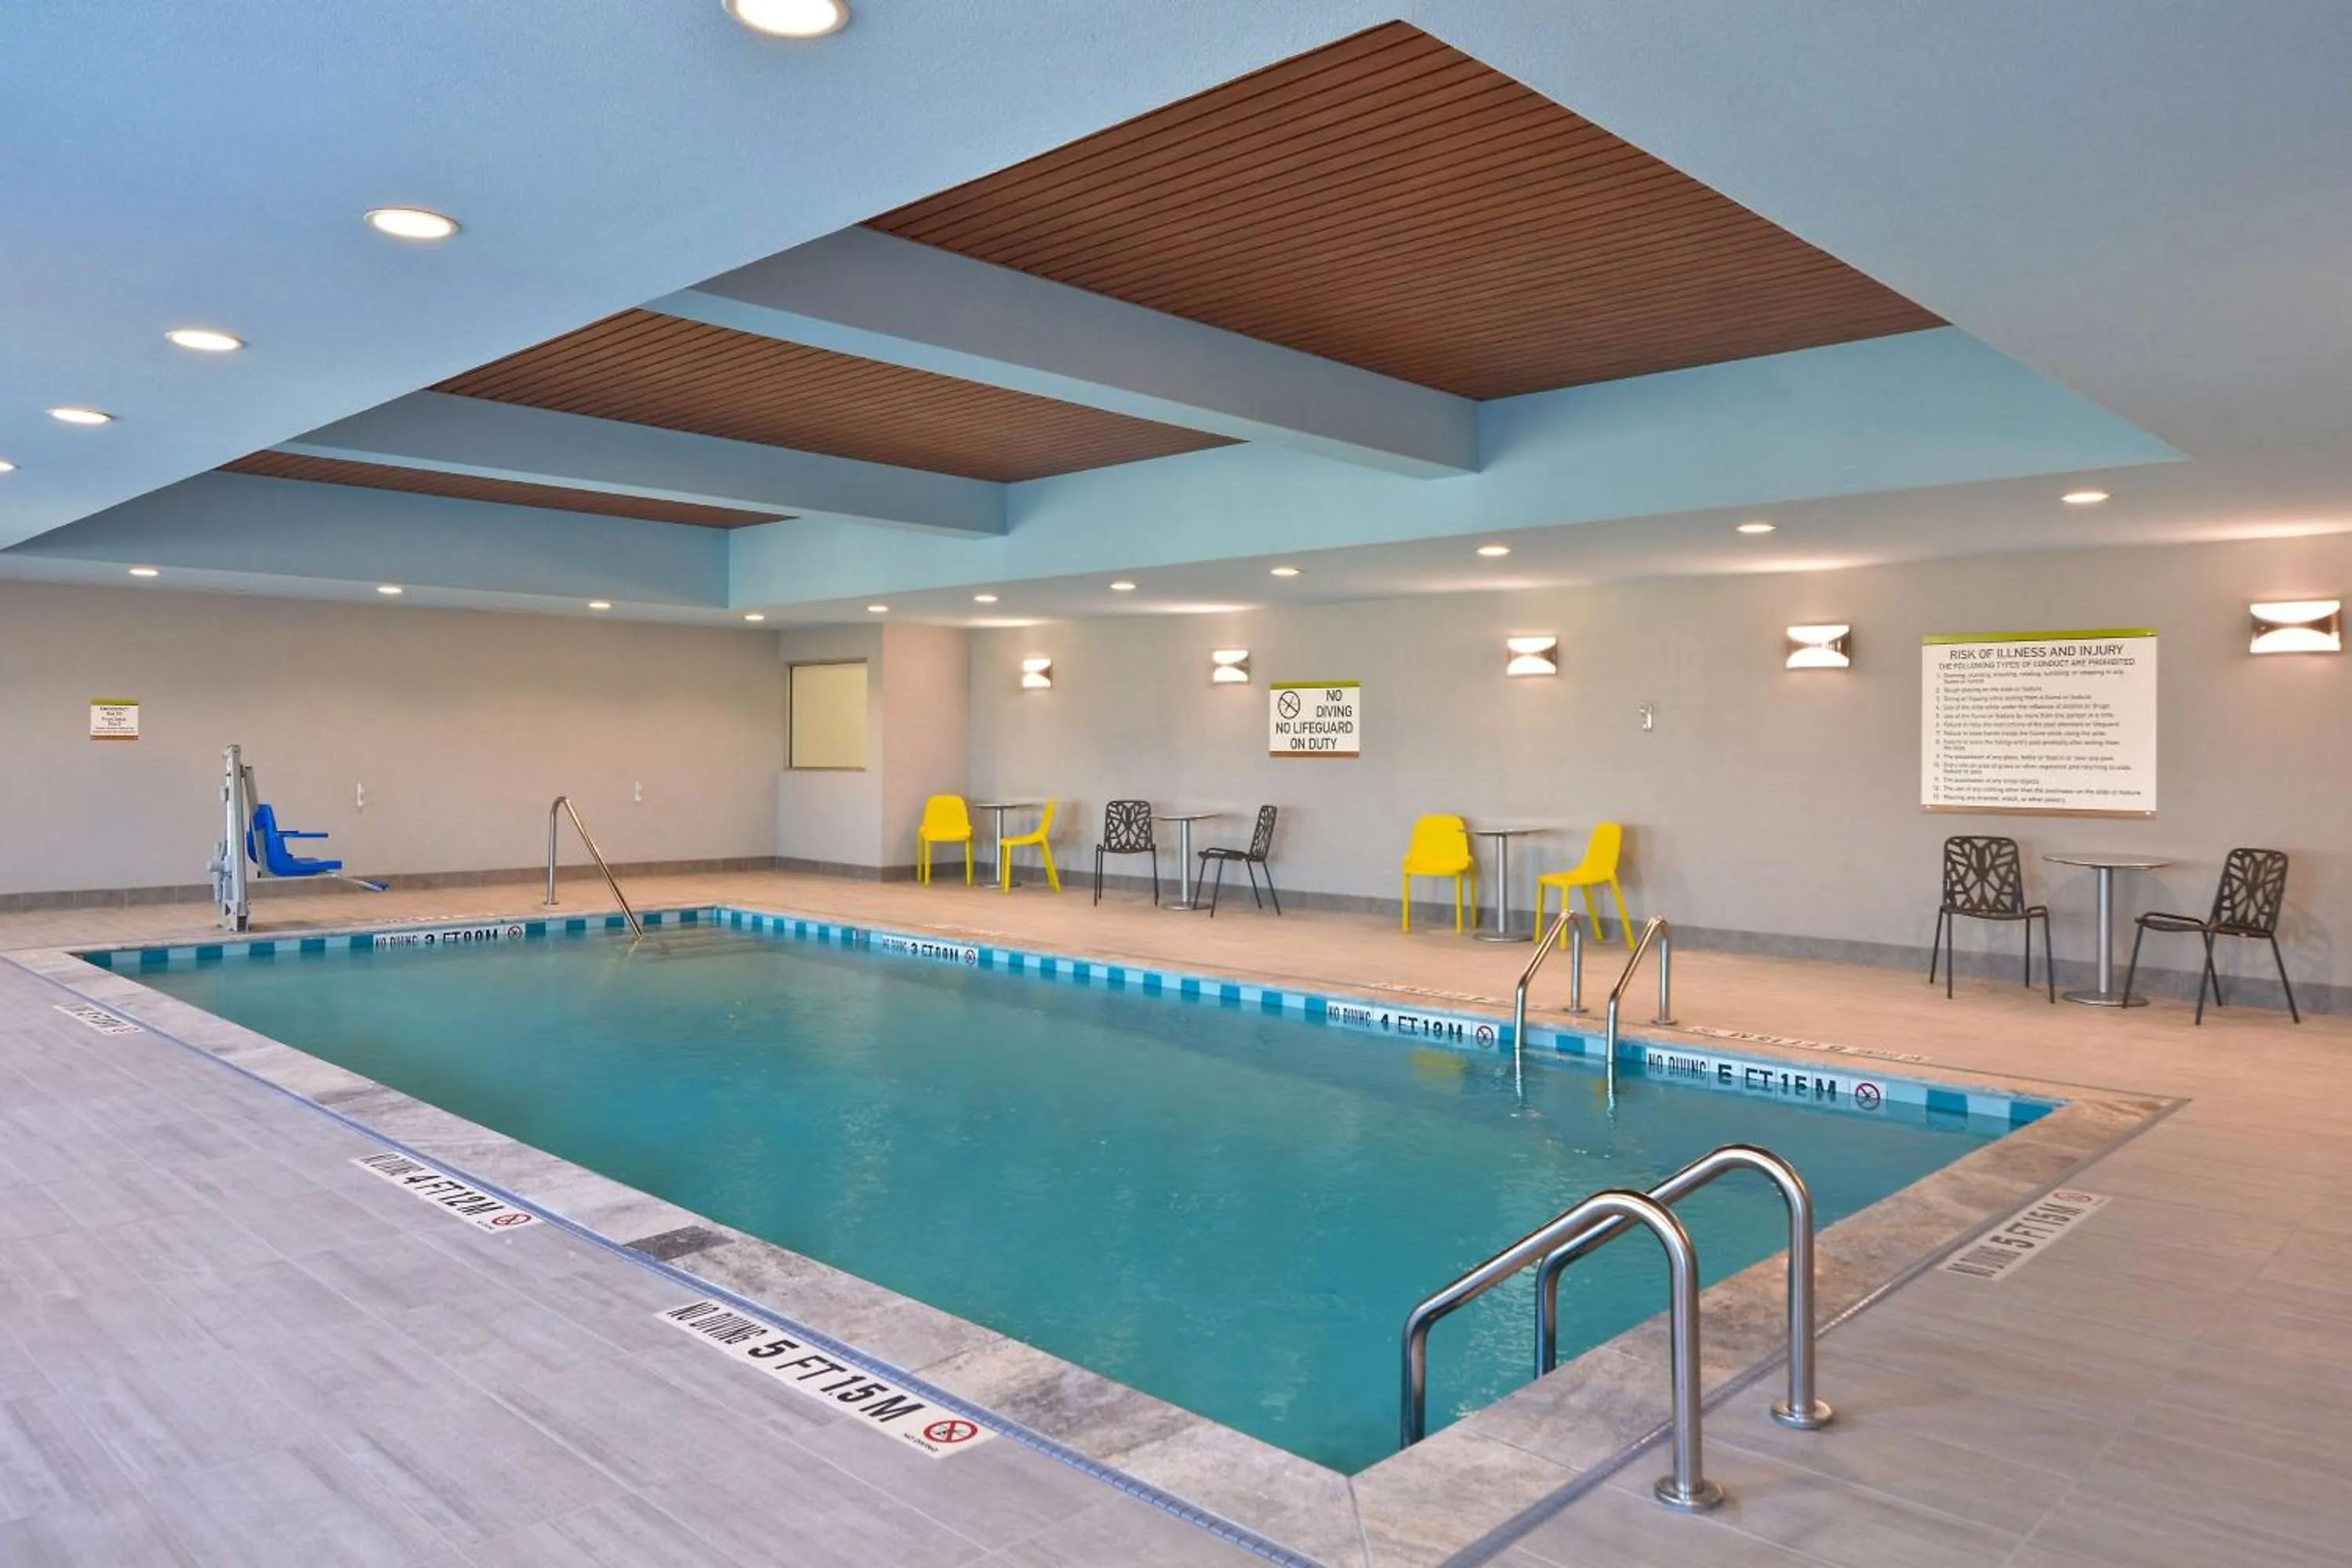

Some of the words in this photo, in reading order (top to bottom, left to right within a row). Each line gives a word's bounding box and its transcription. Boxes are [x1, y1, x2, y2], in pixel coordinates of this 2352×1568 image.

[1950, 649, 1976, 660] RISK
[1979, 648, 1994, 659] OF
[1997, 647, 2046, 659] ILLNESS
[2049, 645, 2076, 657] AND
[2080, 644, 2123, 656] INJURY
[1327, 689, 1342, 702] NO
[1316, 705, 1352, 717] DIVING
[1276, 722, 1290, 735] NO
[1293, 721, 1353, 735] LIFEGUARD
[1290, 738, 1305, 750] ON
[1308, 738, 1338, 750] DUTY
[402, 1174, 441, 1185] 4
[1989, 1235, 2035, 1249] 5
[666, 1301, 720, 1322] NO
[688, 1312, 768, 1345] DIVING
[747, 1338, 800, 1359] 5
[775, 1354, 848, 1381] FT
[858, 1394, 927, 1423] M
